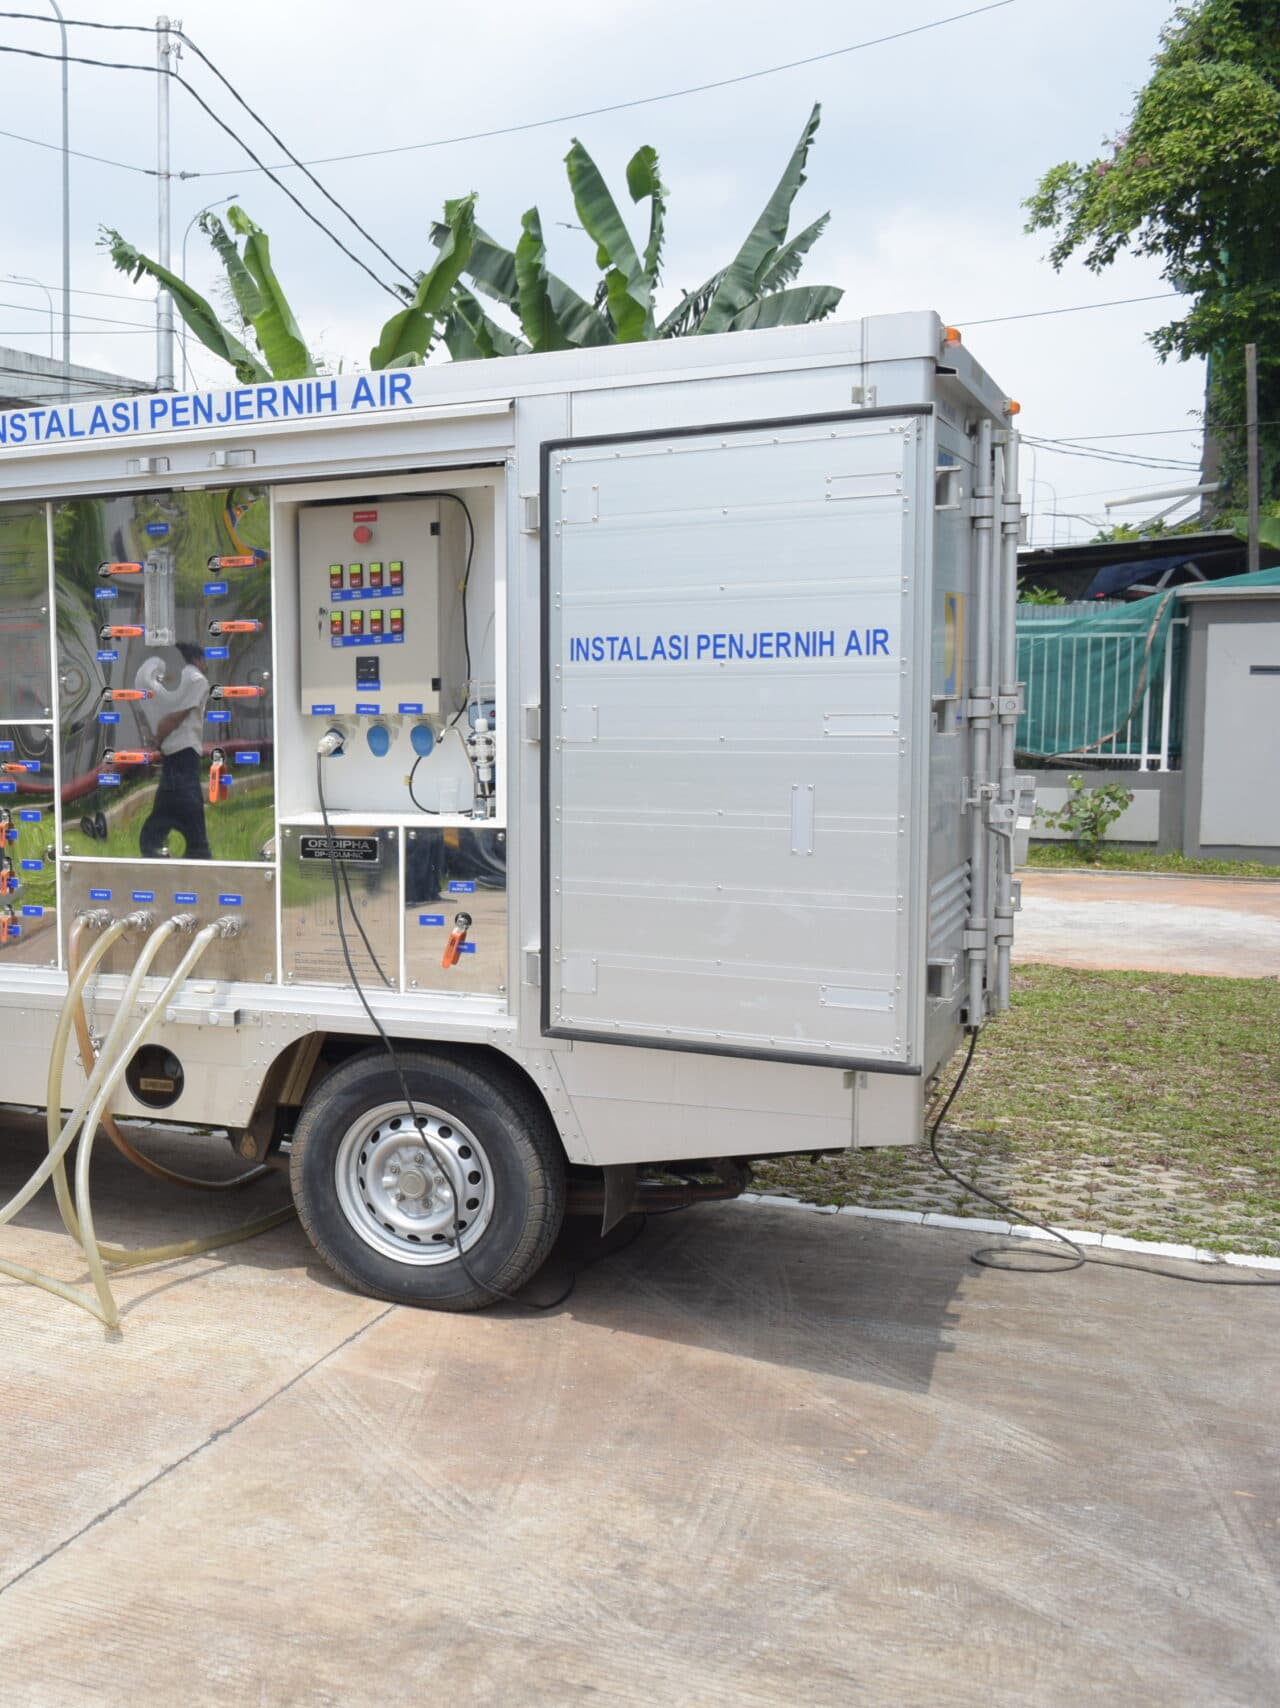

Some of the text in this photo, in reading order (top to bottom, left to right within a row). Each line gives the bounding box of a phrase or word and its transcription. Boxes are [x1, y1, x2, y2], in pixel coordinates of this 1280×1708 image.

[150, 380, 337, 428] PENJERNIH
[351, 373, 413, 409] AIR
[570, 628, 890, 662] INSTALASI PENJERNIH AIR
